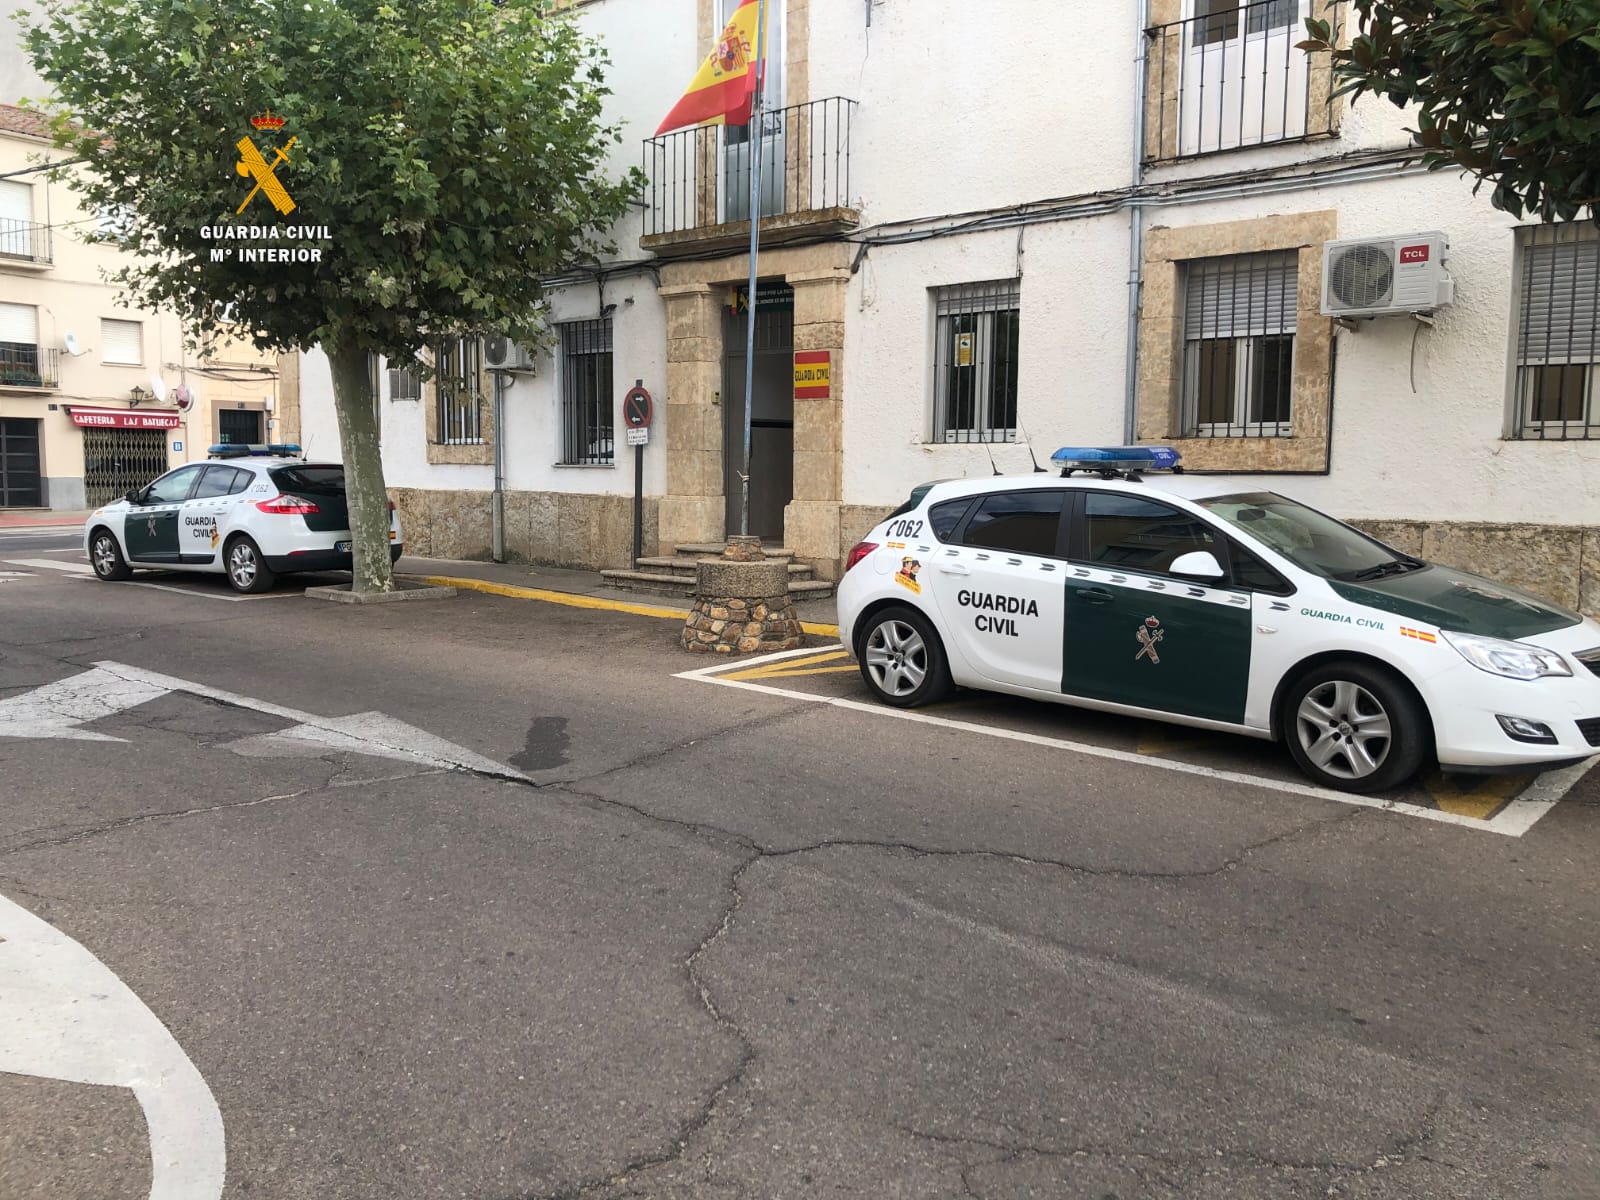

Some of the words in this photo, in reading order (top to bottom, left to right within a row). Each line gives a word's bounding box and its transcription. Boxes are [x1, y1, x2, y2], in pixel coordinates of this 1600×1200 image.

[1404, 250, 1425, 258] TCL
[795, 370, 815, 382] GUARDIA
[816, 368, 830, 380] CIVIL
[74, 415, 115, 425] CAFETERIA
[123, 417, 138, 426] LAS
[142, 418, 179, 427] BATUECAS
[185, 516, 217, 526] GUARDIA
[193, 529, 211, 538] CIVIL
[896, 519, 923, 538] 062
[957, 589, 1039, 617] GUARDIA
[974, 614, 1019, 637] CIVIL
[1300, 607, 1352, 624] GUARDIA
[1355, 618, 1385, 631] CIVIL
